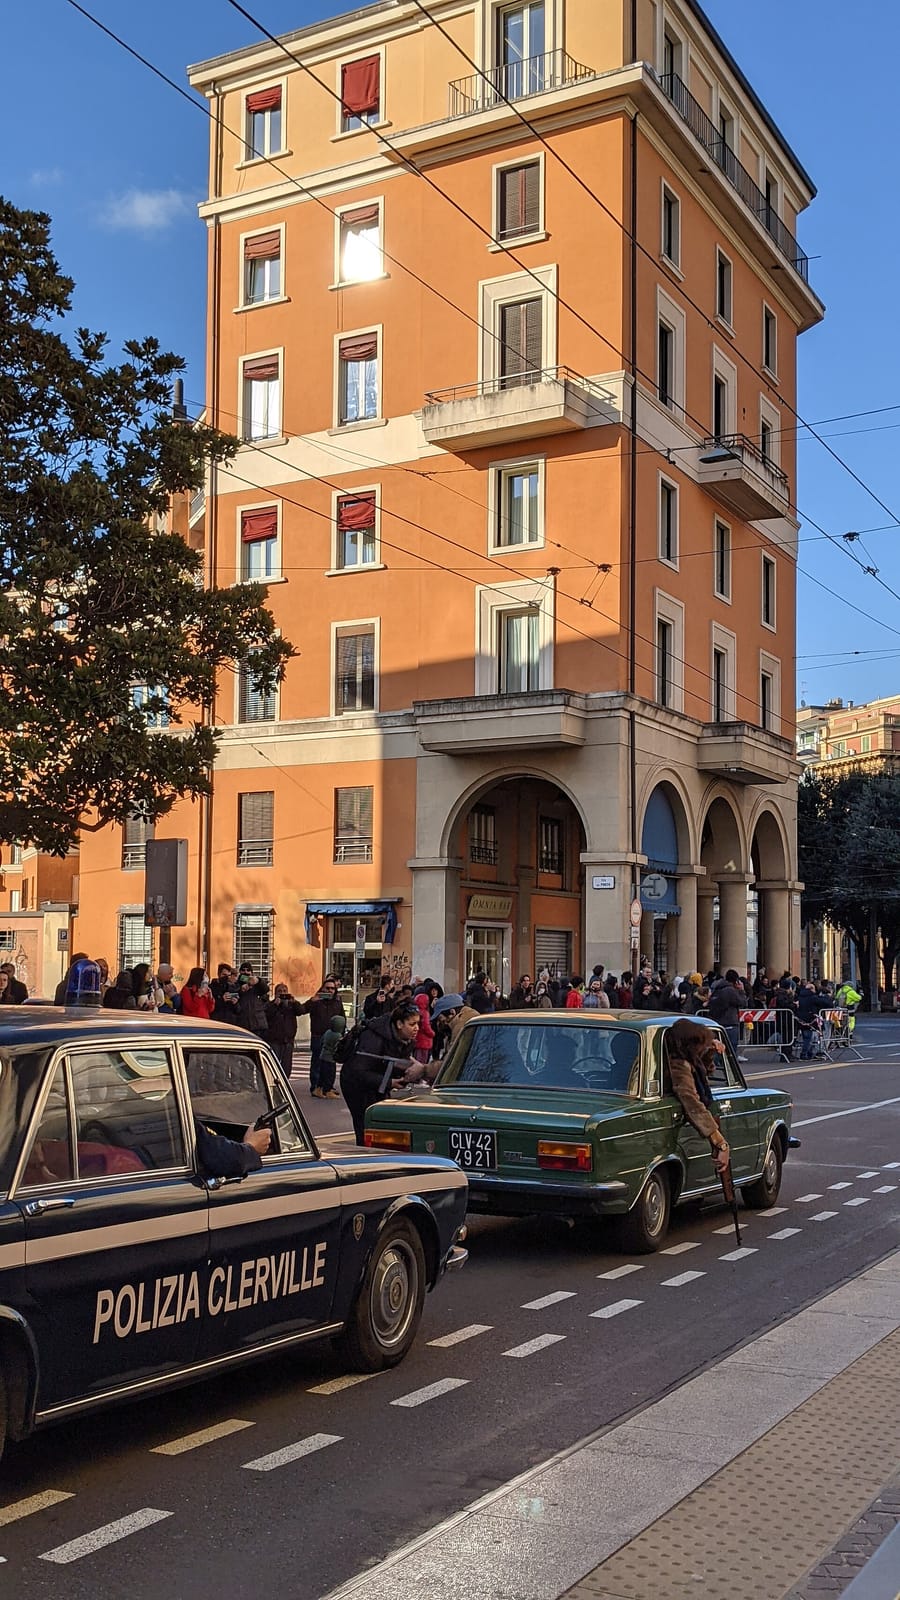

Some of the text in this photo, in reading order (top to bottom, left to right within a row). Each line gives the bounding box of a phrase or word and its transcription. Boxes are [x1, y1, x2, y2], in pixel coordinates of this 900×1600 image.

[451, 1132, 492, 1151] CLV 42
[454, 1151, 490, 1167] 4921
[93, 1242, 327, 1344] POLIZIA CLERVILLE
